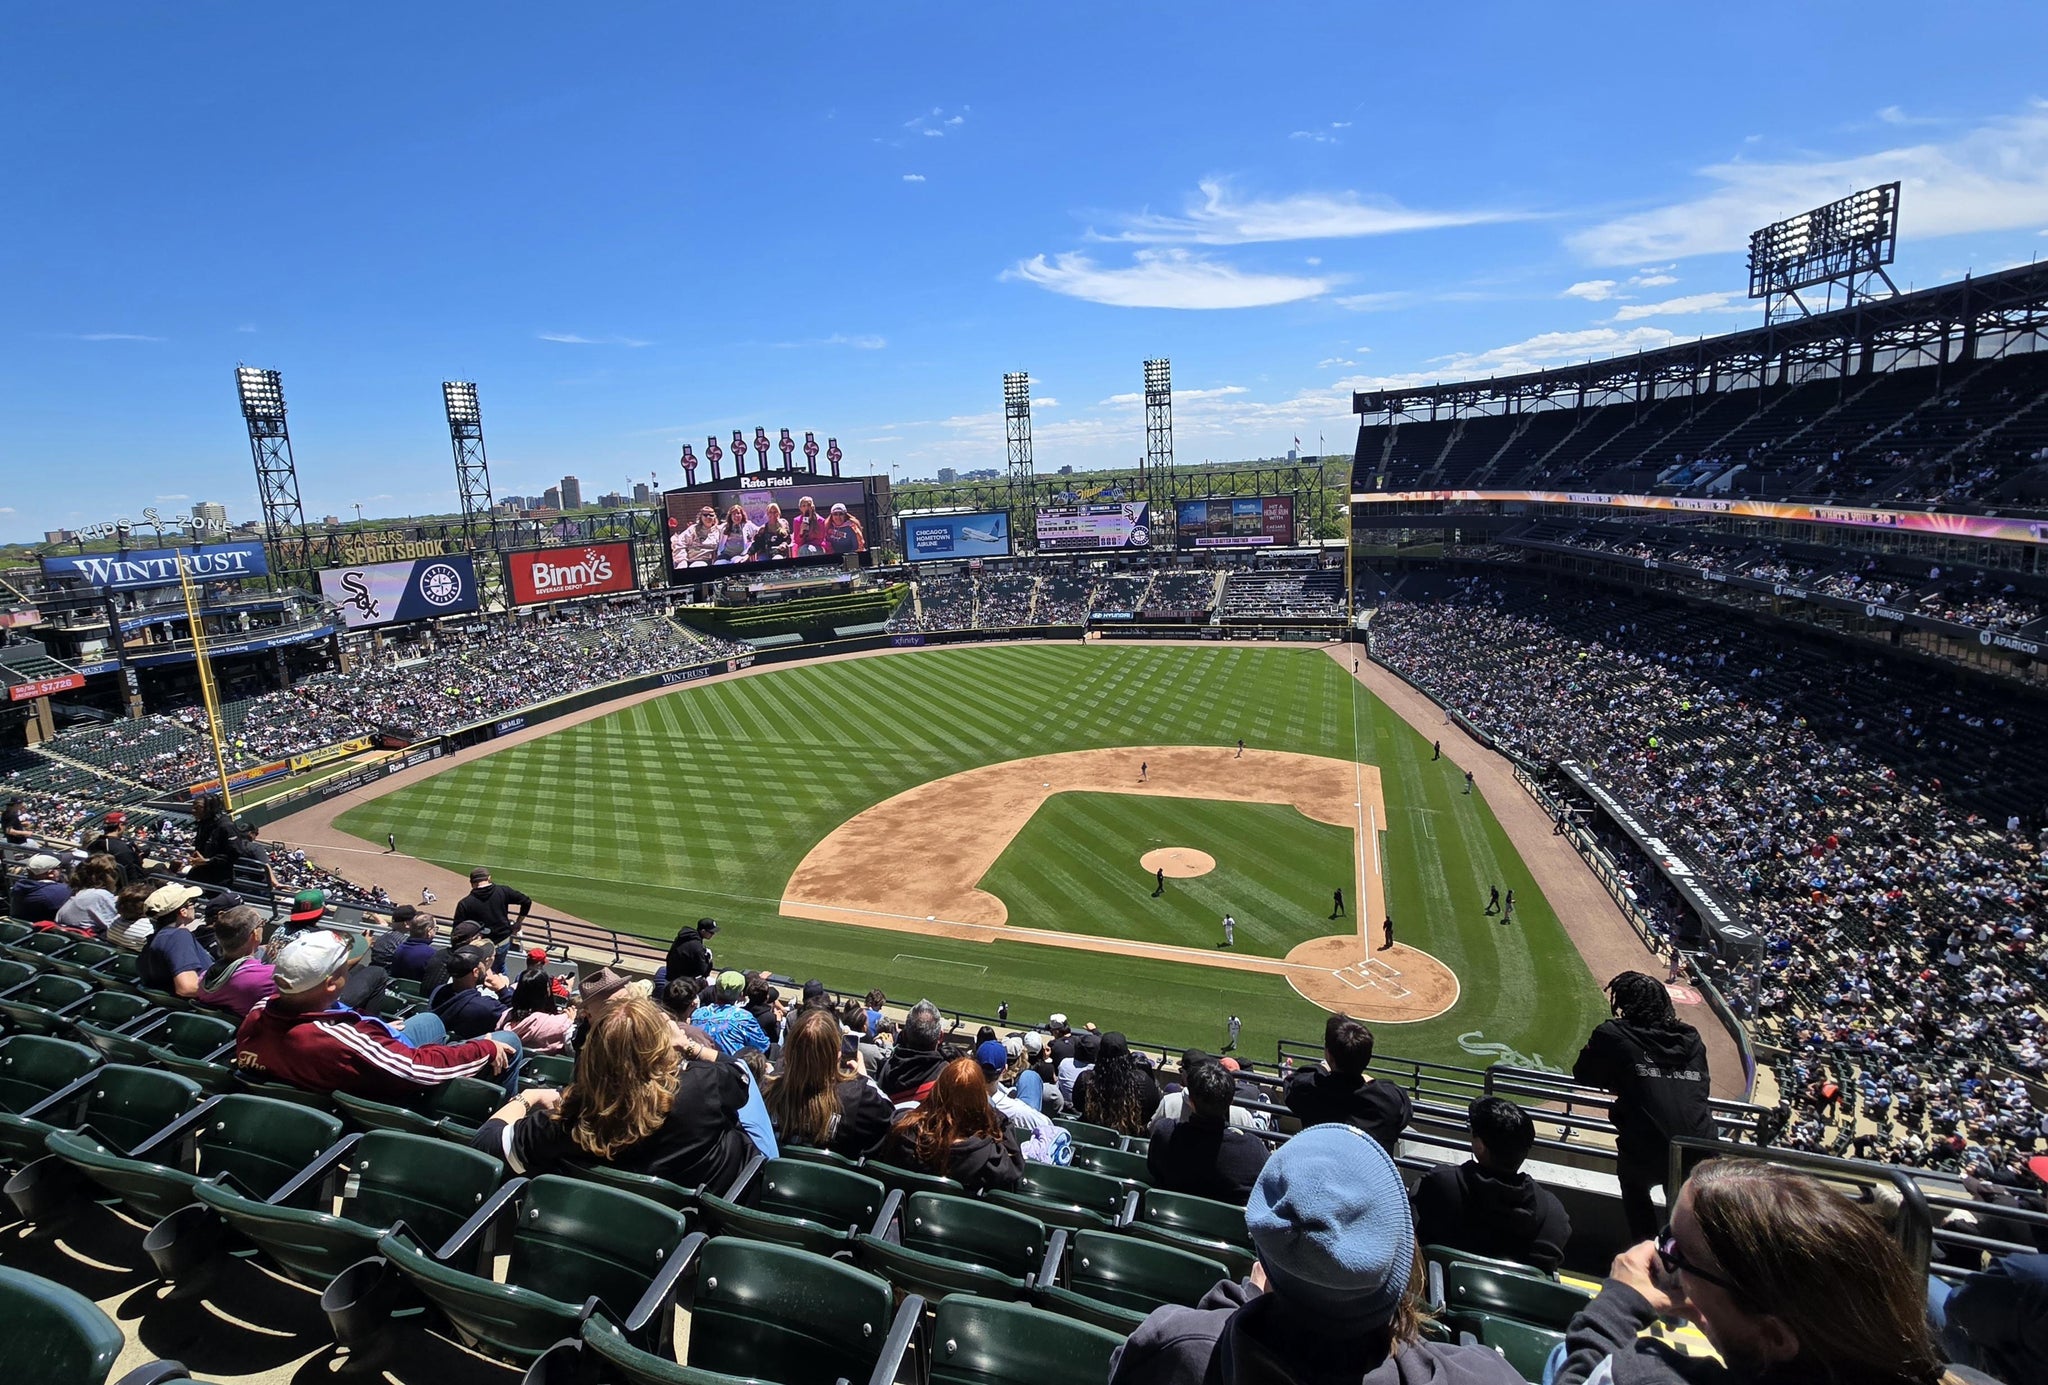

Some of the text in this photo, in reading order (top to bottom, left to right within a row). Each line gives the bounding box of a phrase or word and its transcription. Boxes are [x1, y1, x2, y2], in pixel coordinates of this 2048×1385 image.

[740, 476, 793, 488] Rate Field
[1715, 502, 1726, 510] 20
[1819, 510, 1890, 524] WHAT'S YOUR 20
[74, 519, 133, 543] KIDS
[176, 515, 233, 533] ZONE
[343, 531, 404, 545] CAESARS
[344, 540, 445, 564] SPORTSBOOK
[342, 571, 380, 620] Sox
[535, 584, 583, 595] BEVERAGE DEPOT
[1782, 588, 1807, 599] APPLING
[466, 624, 488, 634] Modelo
[895, 636, 920, 645] xfinity
[1993, 636, 2038, 654] APARICIO
[662, 667, 710, 683] WINTRUST
[15, 684, 35, 693] 50/50
[41, 679, 72, 693] $7,726
[305, 748, 328, 760] Vienna
[328, 745, 342, 754] Beef
[389, 762, 405, 773] Rate
[1645, 837, 1675, 856] Field
[1664, 856, 1694, 876] Rate
[1692, 887, 1730, 922] WELCOME
[1457, 1031, 1564, 1075] Sox
